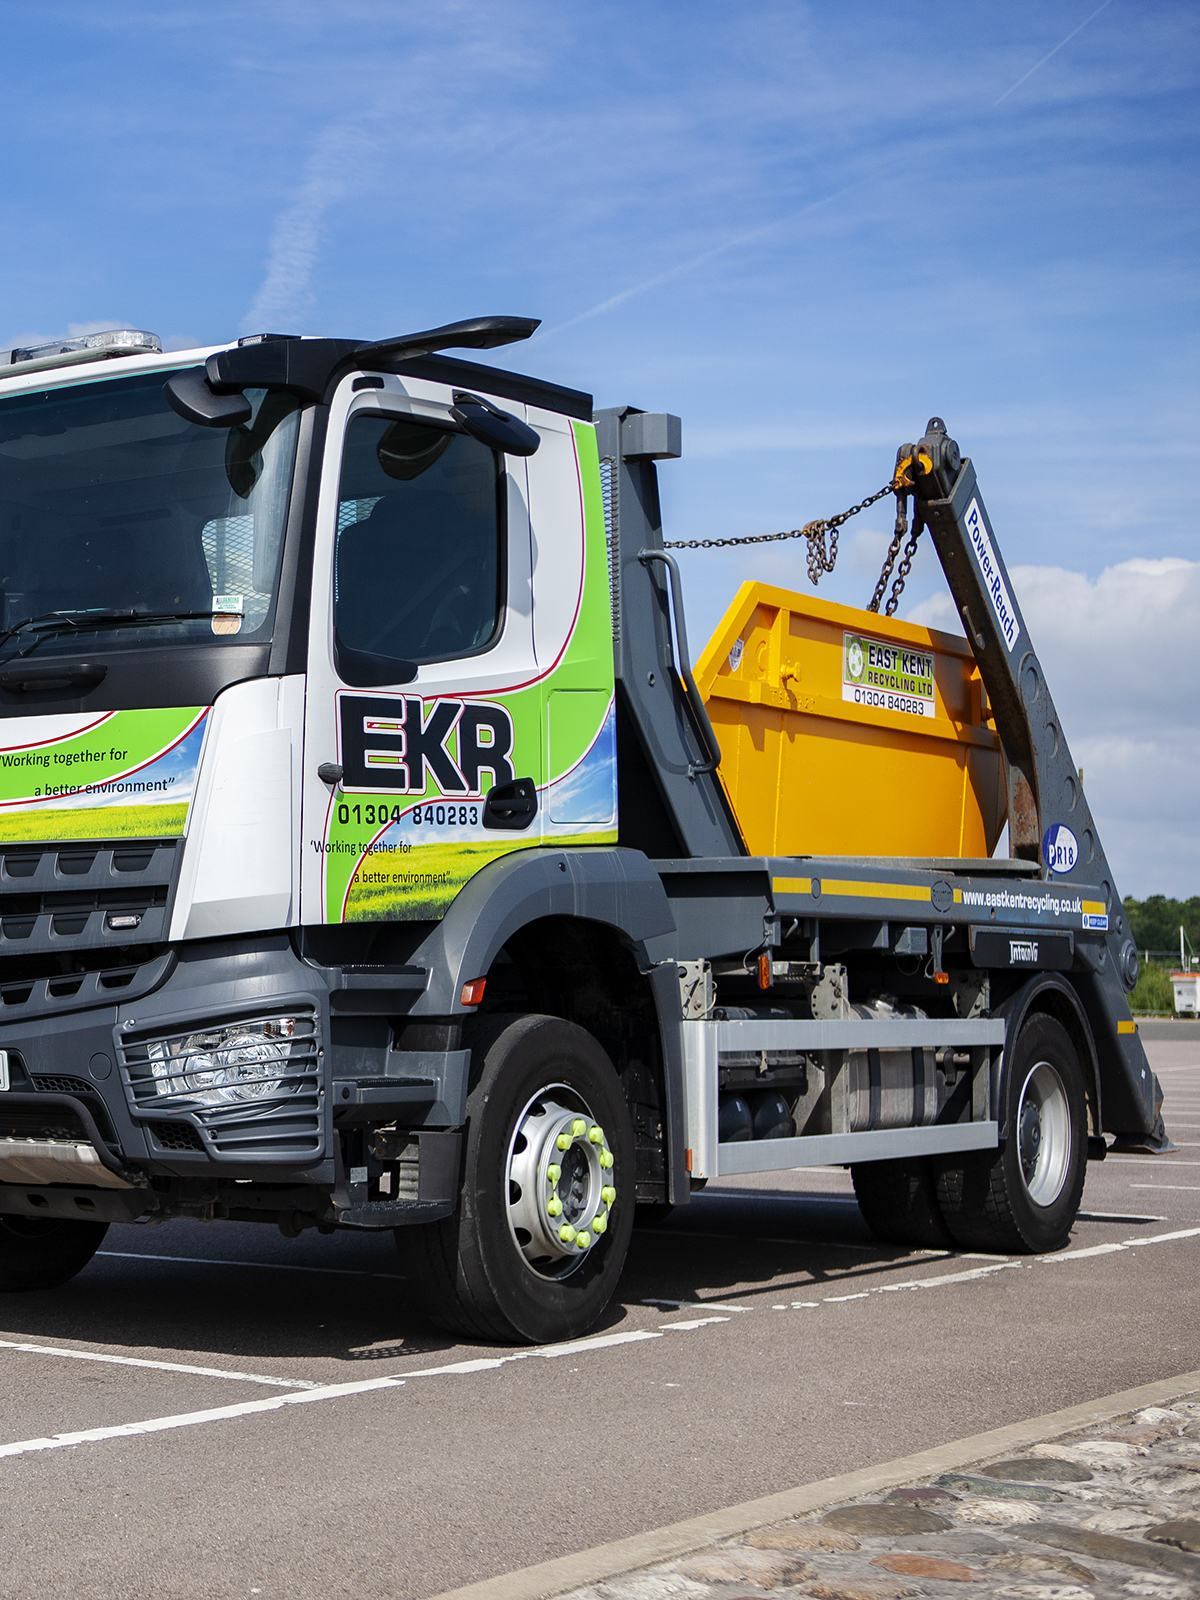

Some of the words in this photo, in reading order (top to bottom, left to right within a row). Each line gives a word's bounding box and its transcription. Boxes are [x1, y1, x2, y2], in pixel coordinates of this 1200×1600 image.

[968, 508, 1014, 643] Power-Reach
[868, 644, 898, 672] EAST
[901, 652, 932, 679] KENT
[868, 671, 915, 692] RECYCLING
[918, 682, 933, 696] LTD
[854, 689, 885, 708] 01304
[887, 696, 924, 715] 840283
[337, 691, 515, 795] EKR
[53, 750, 109, 767] together
[109, 748, 128, 761] for
[34, 787, 41, 796] a
[45, 783, 82, 796] better
[84, 777, 175, 794] environment”
[338, 804, 402, 825] 01304
[412, 805, 478, 825] 840283
[359, 841, 398, 856] together
[399, 841, 412, 853] for
[1049, 844, 1074, 865] PR18
[354, 874, 360, 883] a
[362, 871, 390, 883] better
[392, 871, 450, 883] environment”
[962, 890, 1082, 916] www.eastkentrecycling.co.uk
